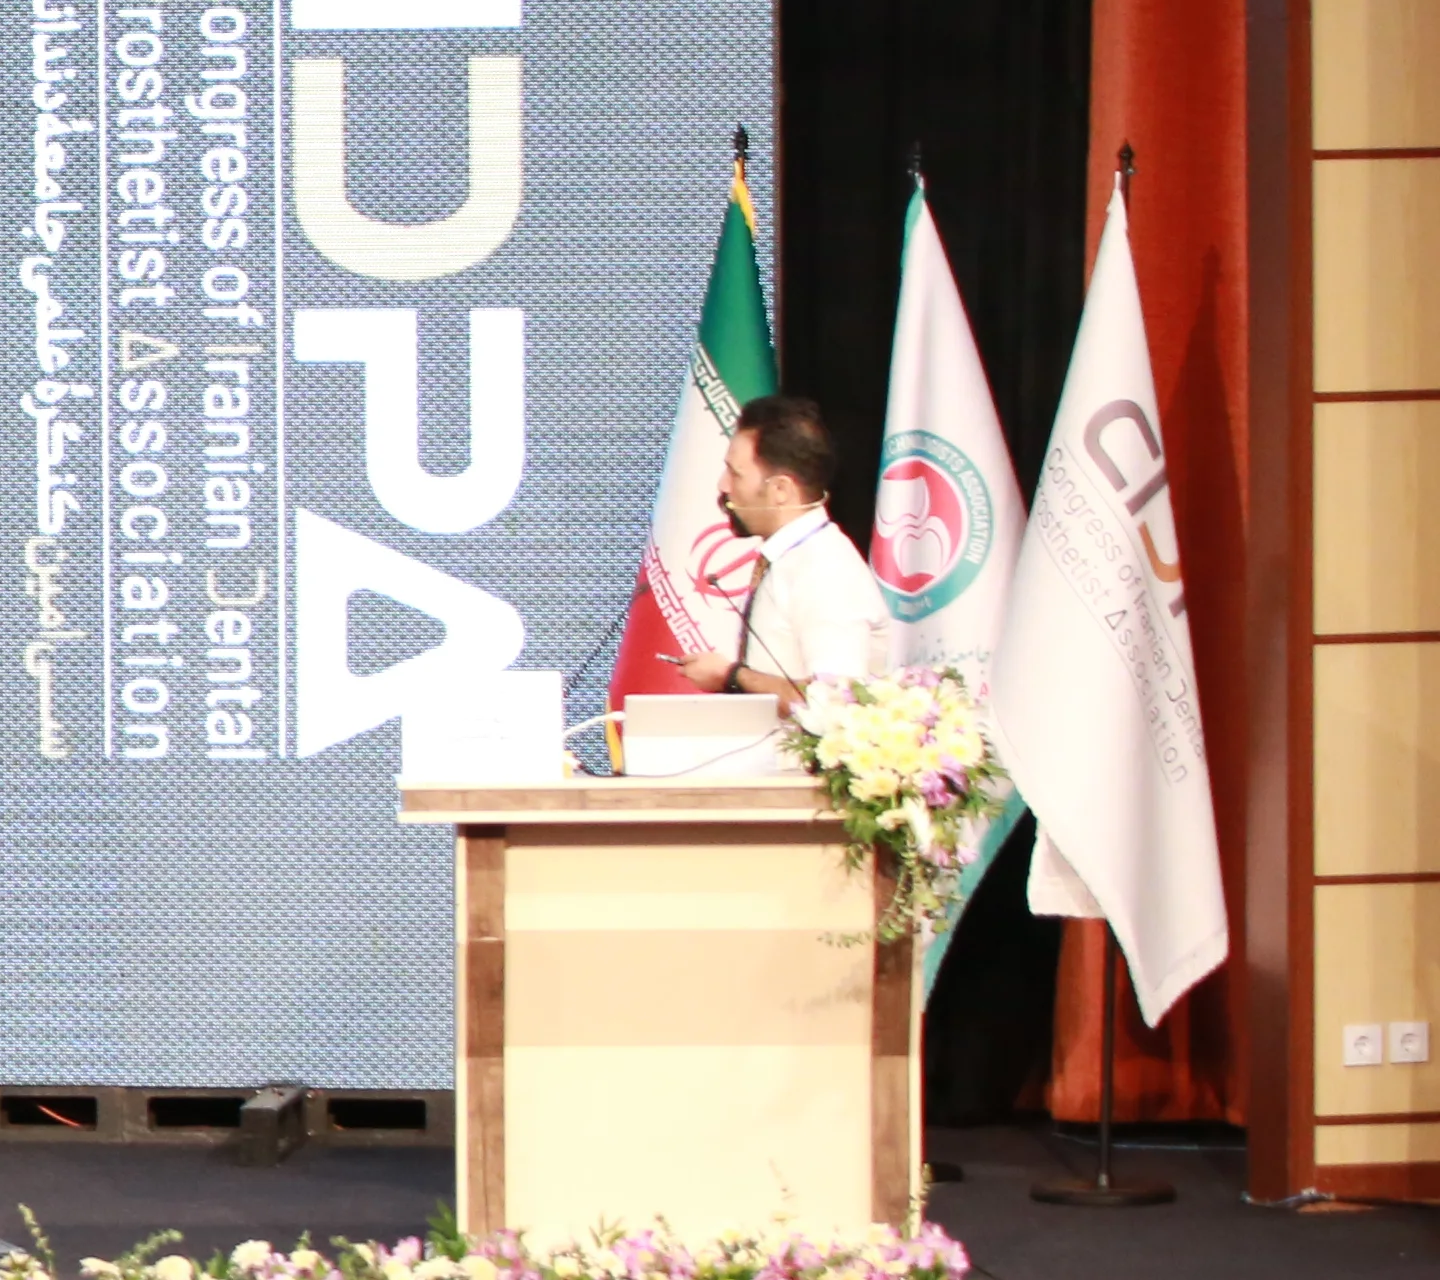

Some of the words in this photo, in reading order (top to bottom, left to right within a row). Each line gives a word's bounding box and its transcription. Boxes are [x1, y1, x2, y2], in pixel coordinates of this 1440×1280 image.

[203, 266, 262, 326] of
[203, 344, 264, 547] Iranian
[1047, 447, 1124, 562] Congress
[118, 331, 183, 759] Association
[205, 570, 267, 759] Dental
